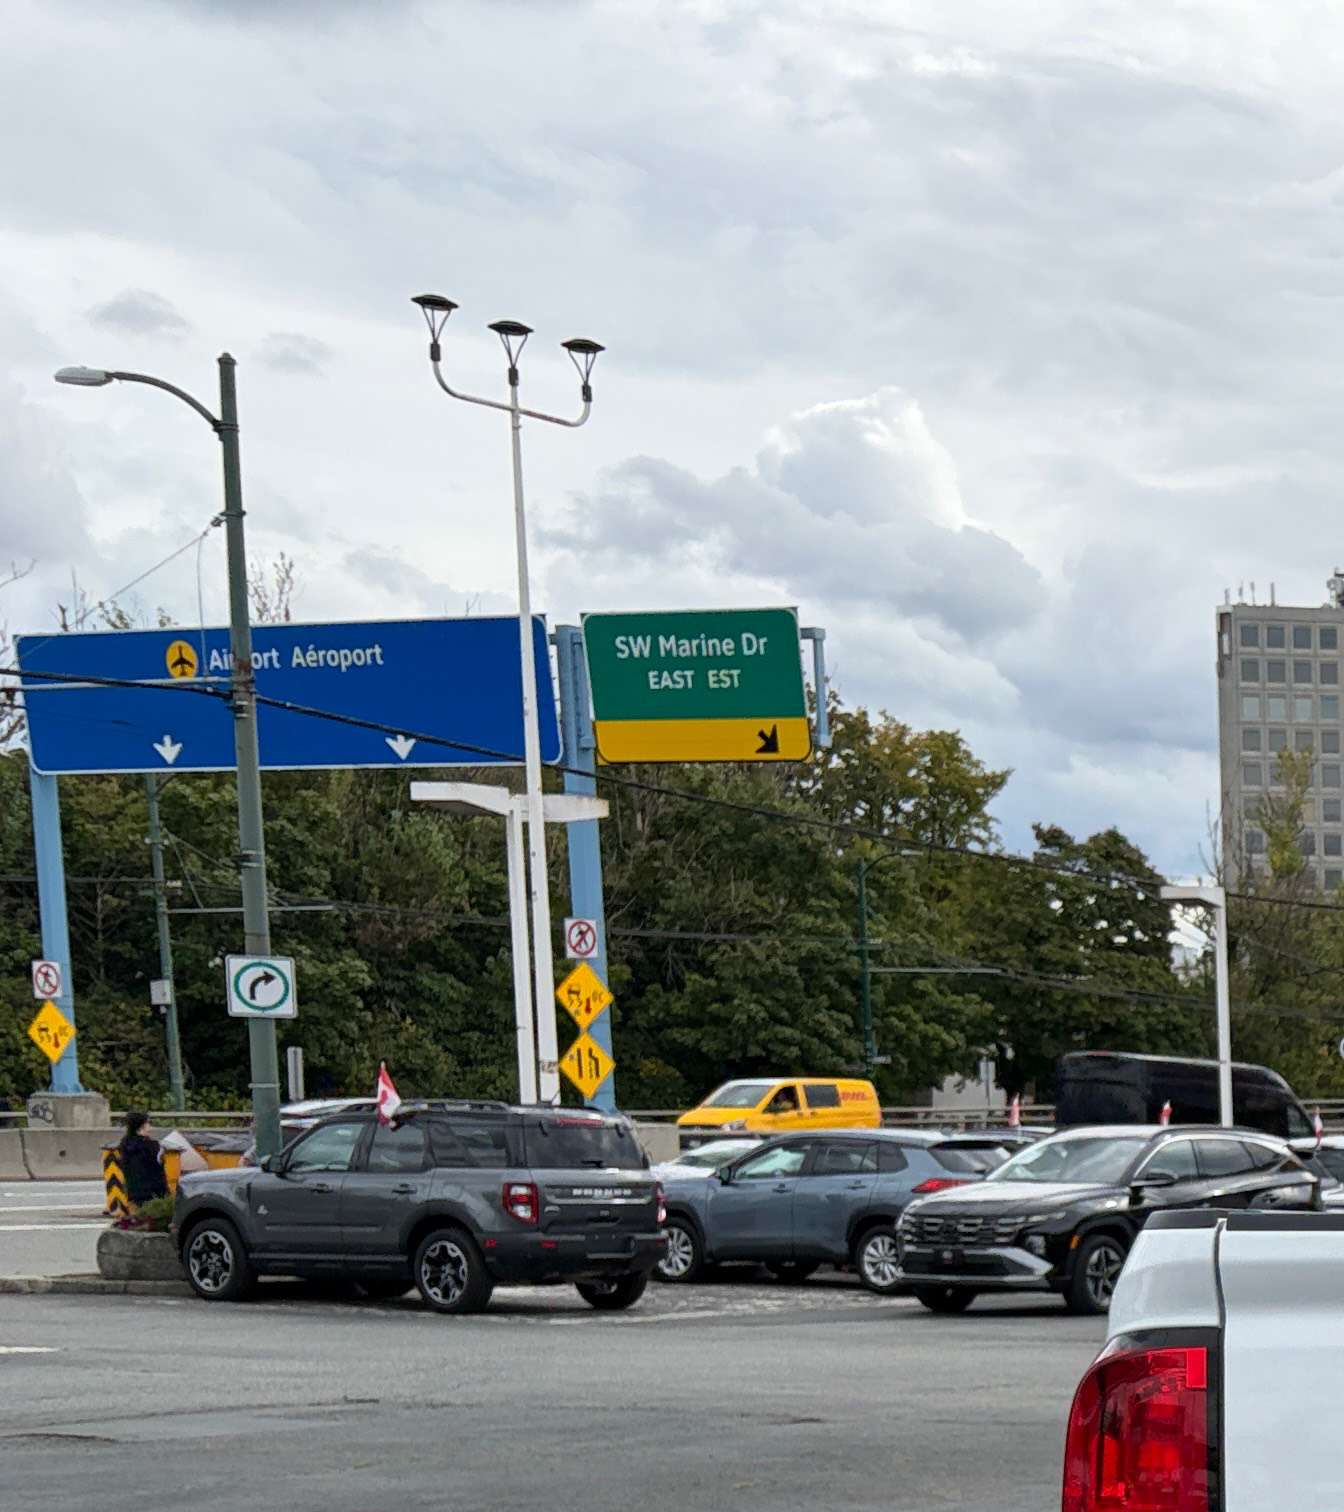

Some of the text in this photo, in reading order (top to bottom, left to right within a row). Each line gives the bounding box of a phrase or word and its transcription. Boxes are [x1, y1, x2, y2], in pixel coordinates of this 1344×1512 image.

[209, 644, 384, 672] Airort Aéroport
[615, 632, 768, 659] SW Marine Dr
[648, 669, 741, 690] EAST EST
